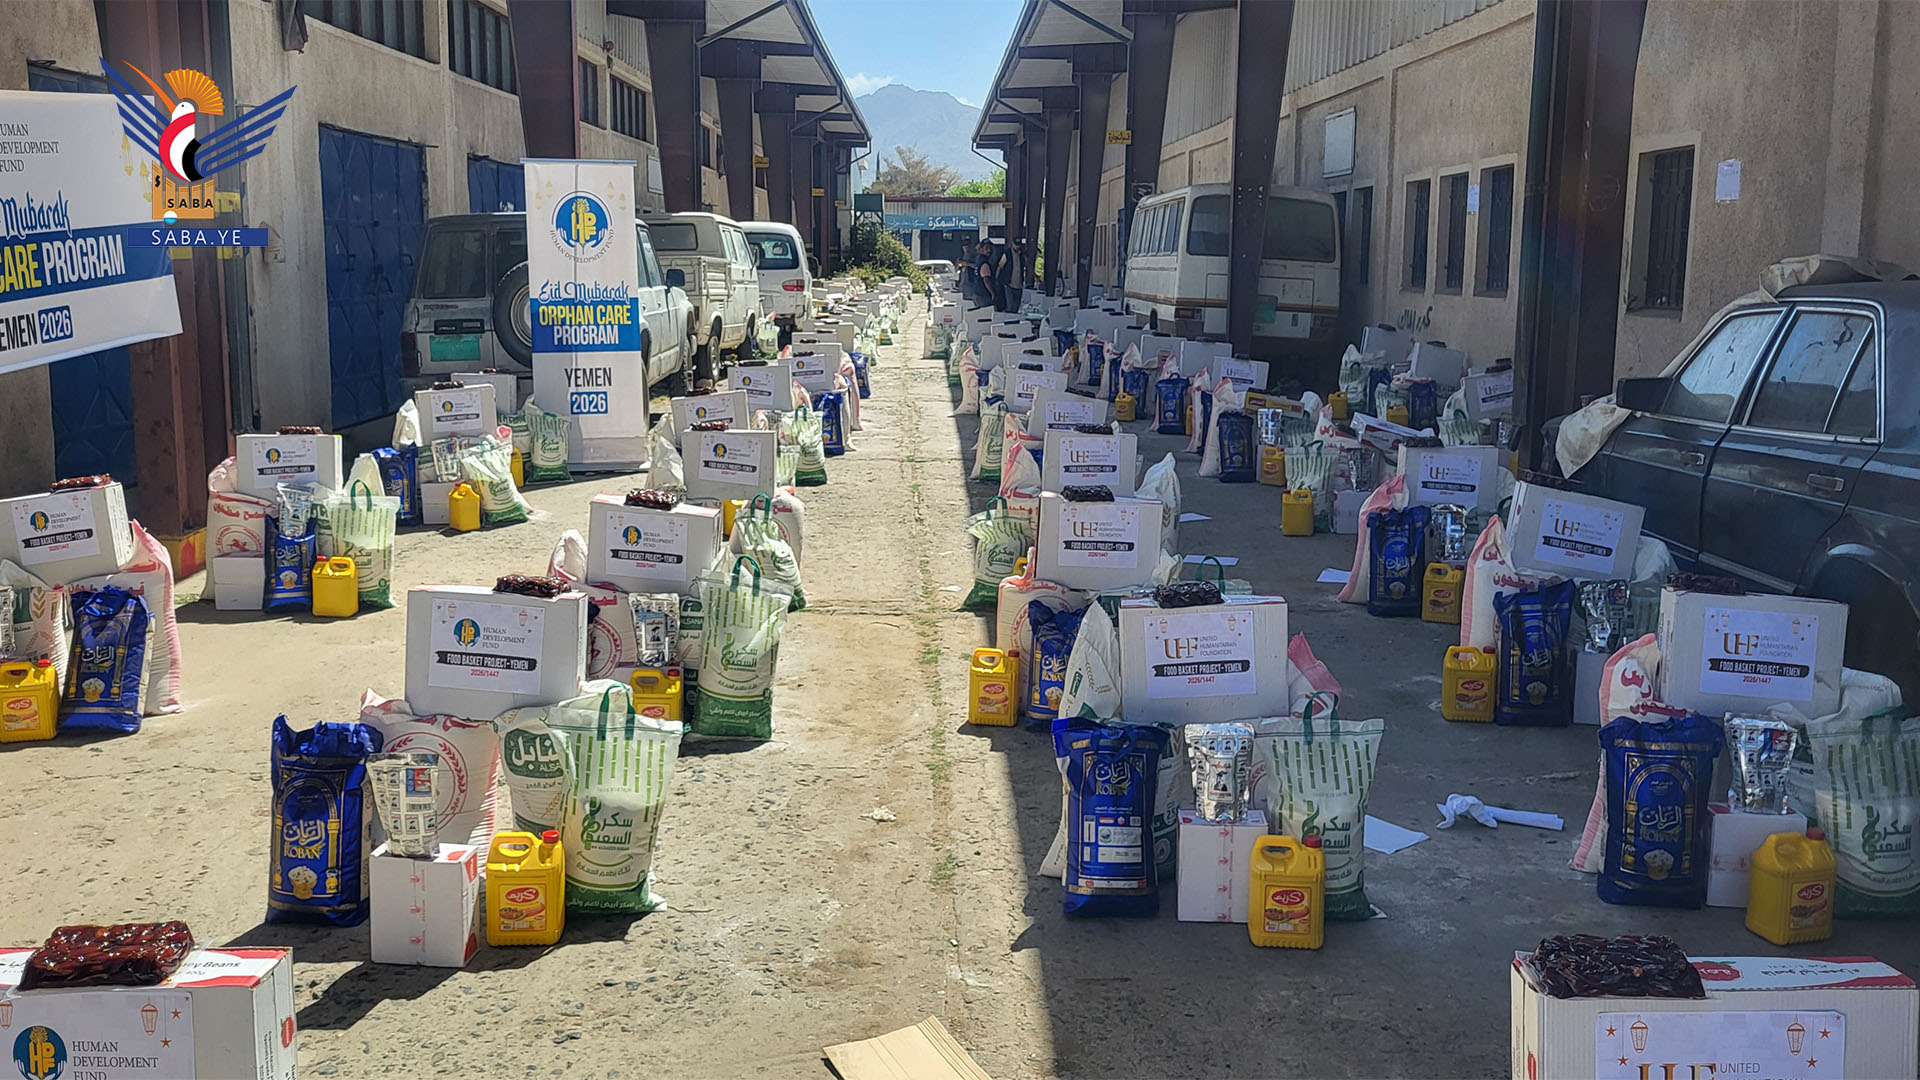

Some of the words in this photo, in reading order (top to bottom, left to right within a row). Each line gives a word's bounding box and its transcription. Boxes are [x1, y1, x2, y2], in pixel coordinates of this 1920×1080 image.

[0, 160, 24, 172] FUND
[42, 234, 127, 286] PROGRAM
[538, 280, 560, 304] Eid
[564, 281, 630, 304] Mubarak
[41, 309, 72, 340] 2026
[539, 305, 593, 326] ORPHAN
[597, 304, 631, 325] CARE
[554, 325, 619, 345] PROGRAM
[564, 368, 612, 387] YEMEN
[572, 394, 606, 413] 2026
[1073, 521, 1098, 538] UHF
[1164, 637, 1198, 659] UHF
[1723, 632, 1759, 656] UHF
[446, 653, 461, 664] FOOD
[461, 655, 483, 666] BASKET
[1720, 660, 1734, 671] FOOD
[1735, 662, 1755, 673] BASKET
[1164, 665, 1177, 675] FOOD
[1178, 664, 1198, 675] BASKET
[601, 812, 633, 831] سكر
[72, 1041, 118, 1052] HUMAN
[73, 1056, 159, 1068] DEVELOPMENT
[1720, 1062, 1760, 1074] UNITED
[74, 1071, 107, 1080] FUND
